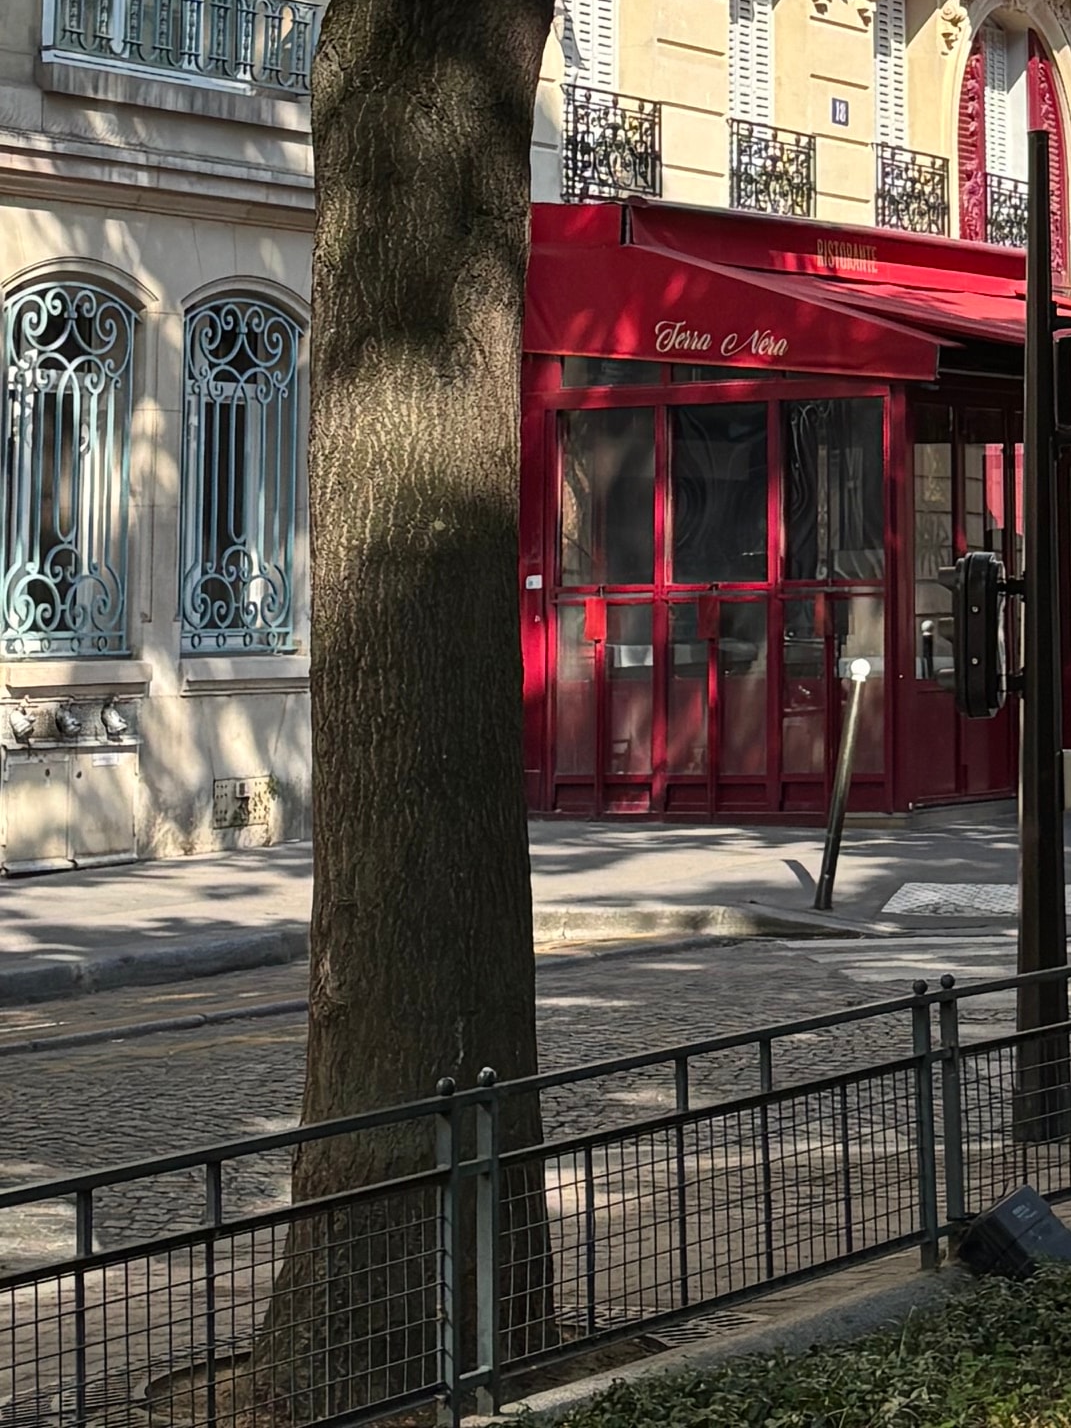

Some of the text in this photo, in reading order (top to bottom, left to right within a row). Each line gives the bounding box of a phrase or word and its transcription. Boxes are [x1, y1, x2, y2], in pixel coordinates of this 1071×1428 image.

[835, 101, 847, 123] 18
[816, 238, 879, 274] RISTORANTE
[654, 320, 789, 357] Terra Nera
